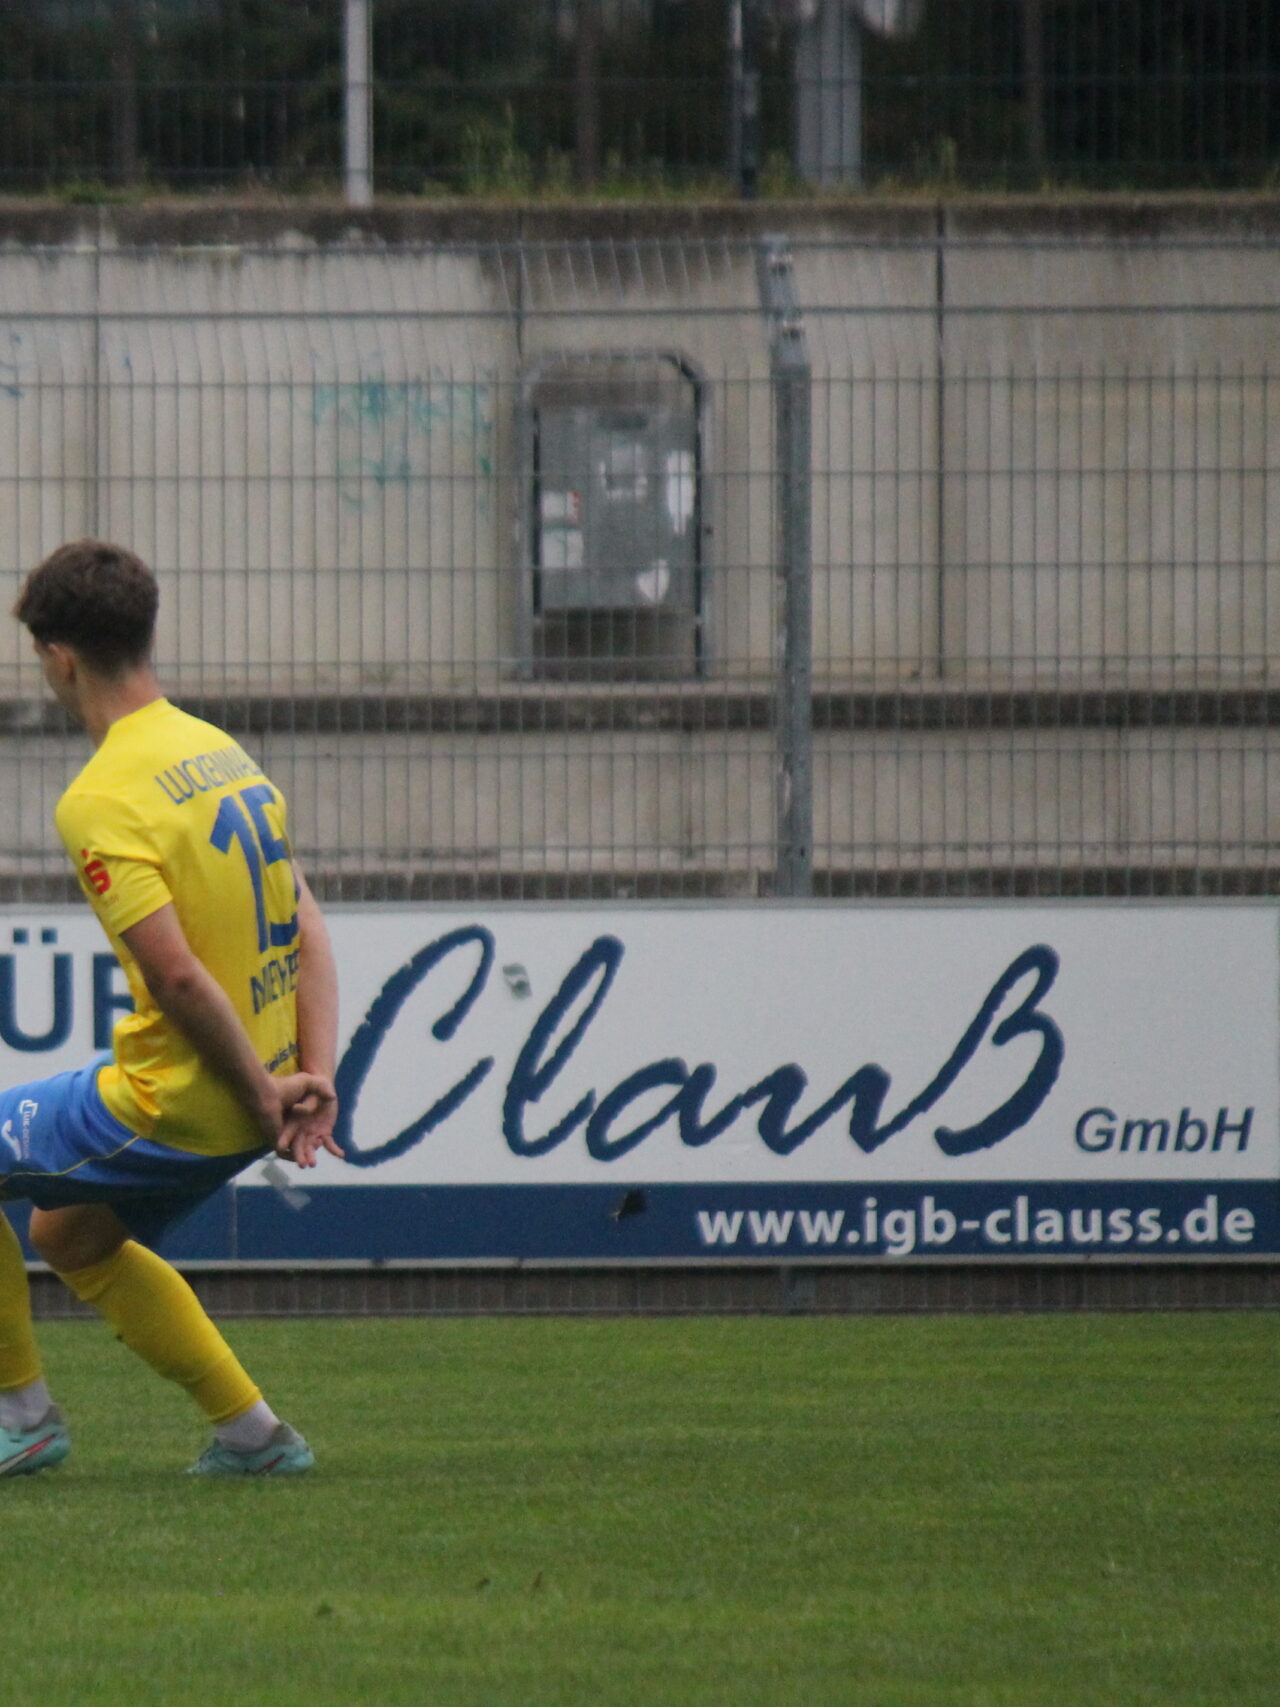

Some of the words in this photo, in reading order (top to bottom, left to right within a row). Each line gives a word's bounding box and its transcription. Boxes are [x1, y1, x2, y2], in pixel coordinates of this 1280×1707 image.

[210, 784, 300, 954] 15
[1074, 1106, 1255, 1154] GmbH
[696, 1195, 1256, 1256] www.igb-clauss.de
